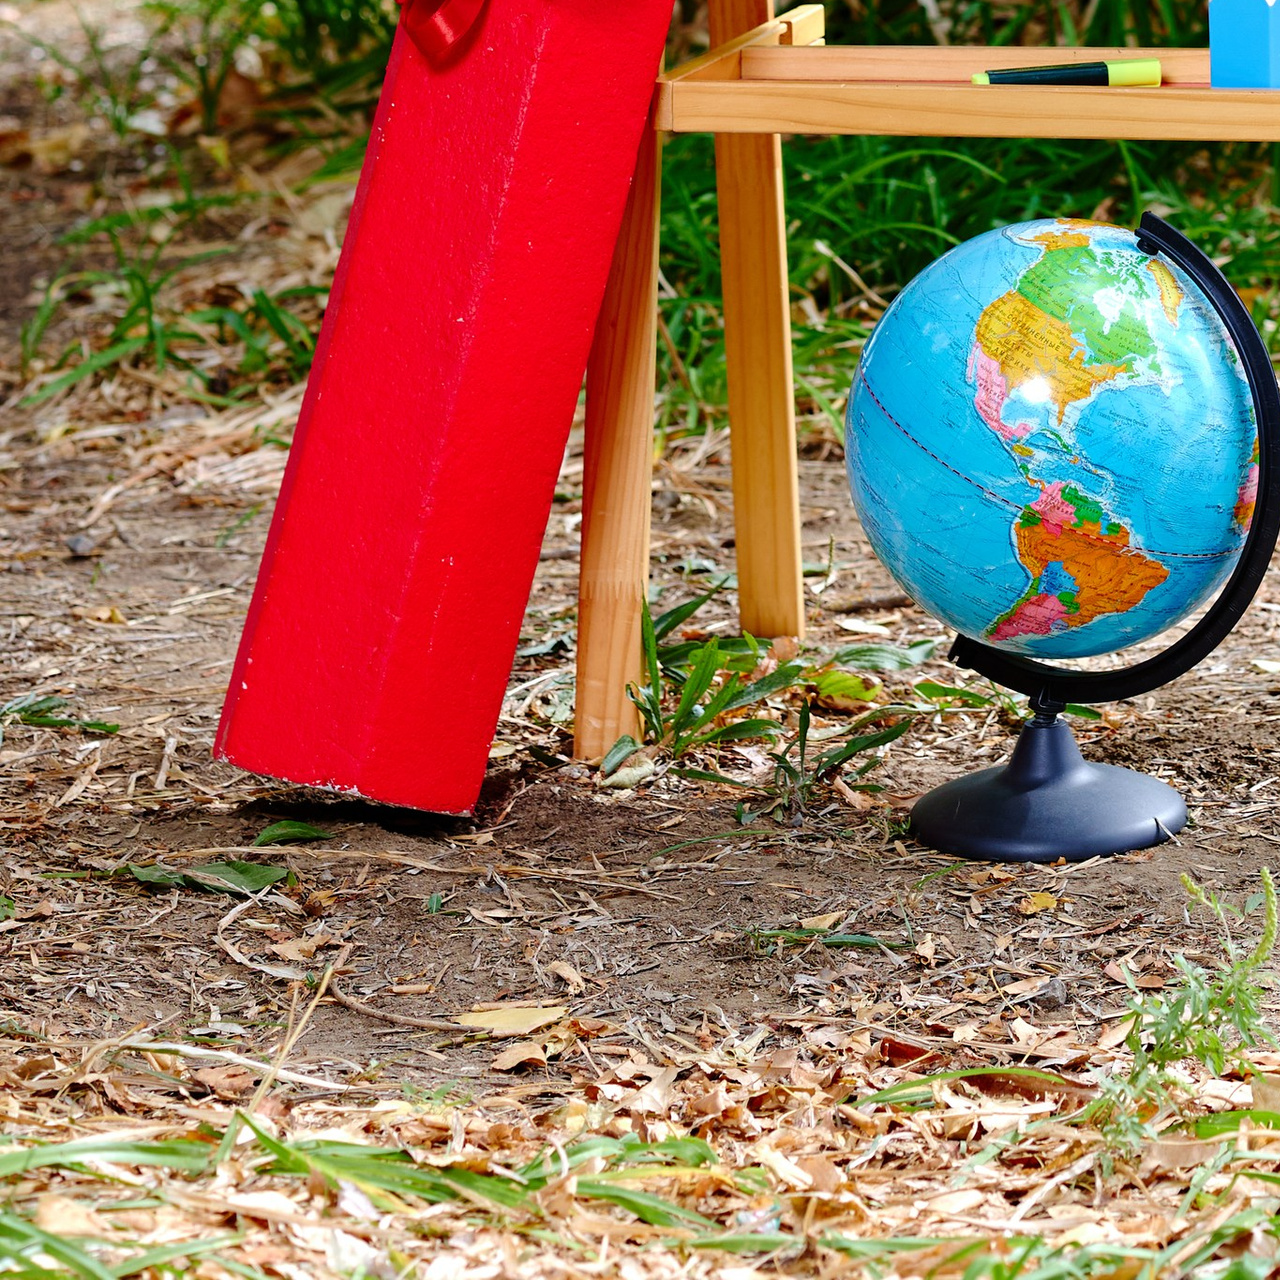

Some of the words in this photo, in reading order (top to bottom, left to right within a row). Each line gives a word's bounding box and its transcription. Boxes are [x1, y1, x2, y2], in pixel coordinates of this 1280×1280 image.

[1007, 313, 1061, 352] СОЕДИНЕННЫЕ
[993, 346, 1031, 372] АМЕРИКИ
[1003, 338, 1034, 358] ШТАТЫ
